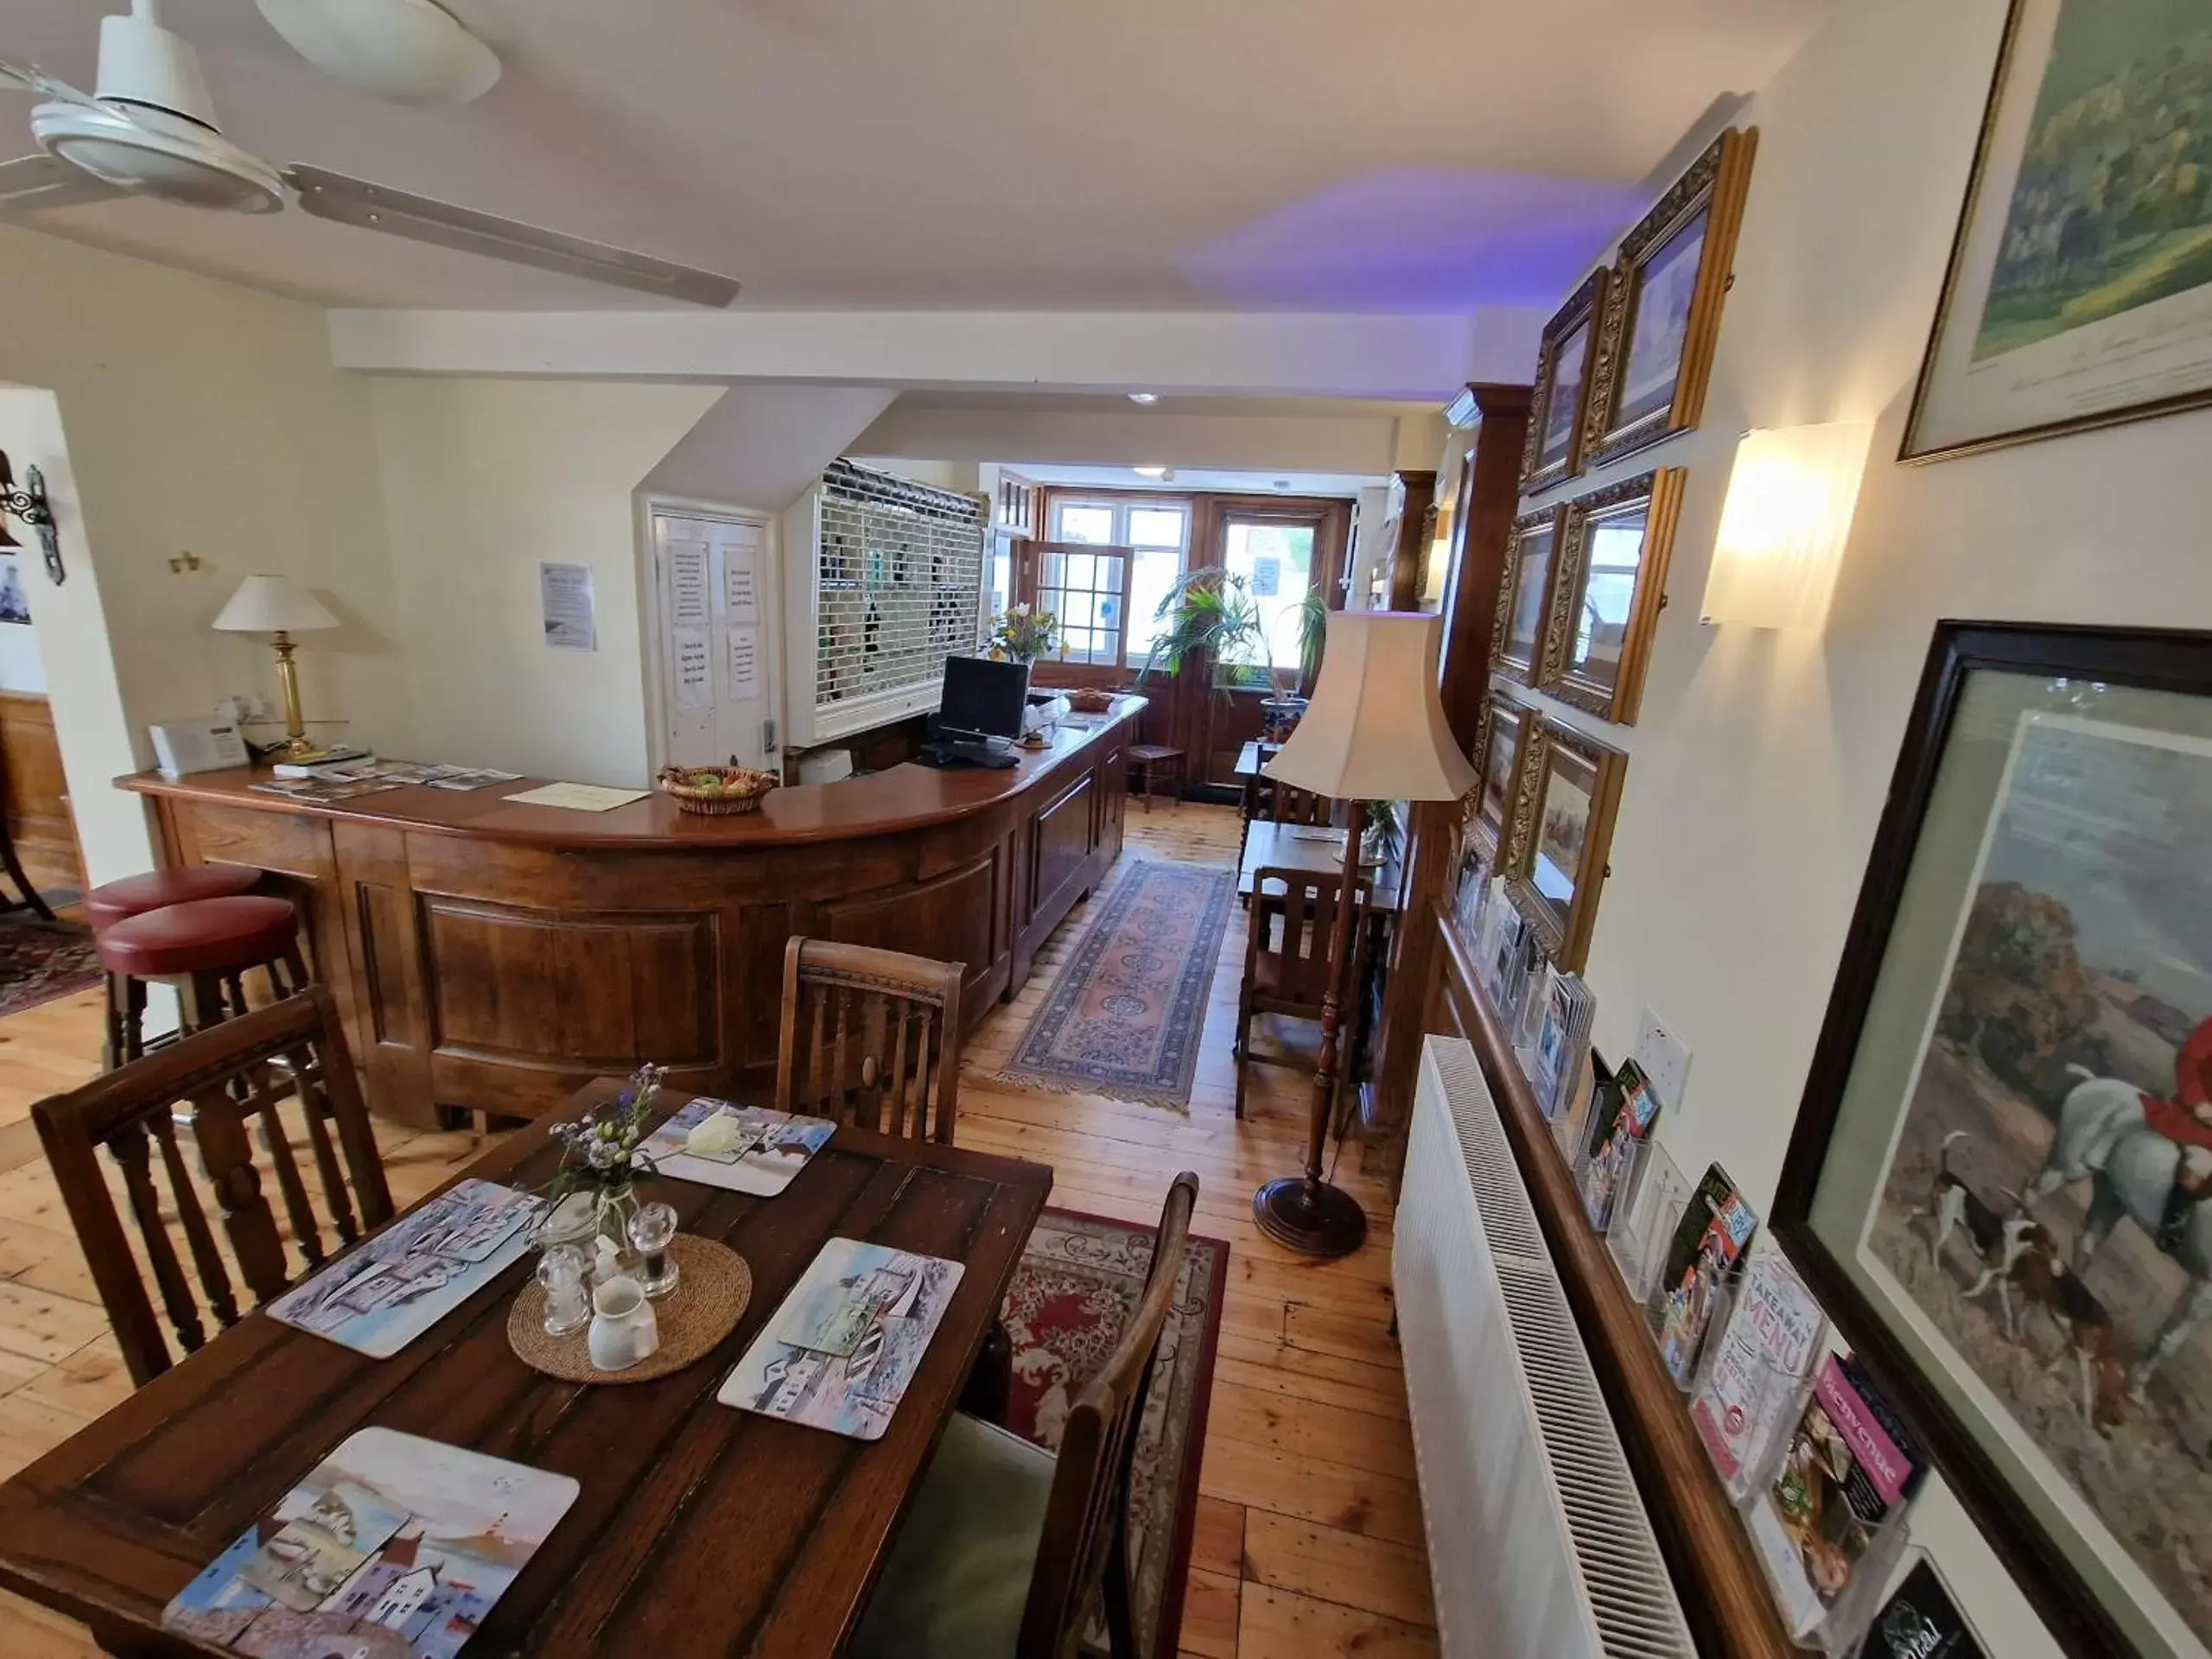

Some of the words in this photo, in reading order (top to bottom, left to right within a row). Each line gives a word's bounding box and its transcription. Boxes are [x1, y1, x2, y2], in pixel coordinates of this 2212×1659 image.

[1742, 1287, 1802, 1373] MENU
[1750, 1272, 1812, 1349] TAKEAWAY
[1821, 1368, 1897, 1486] bienvenue
